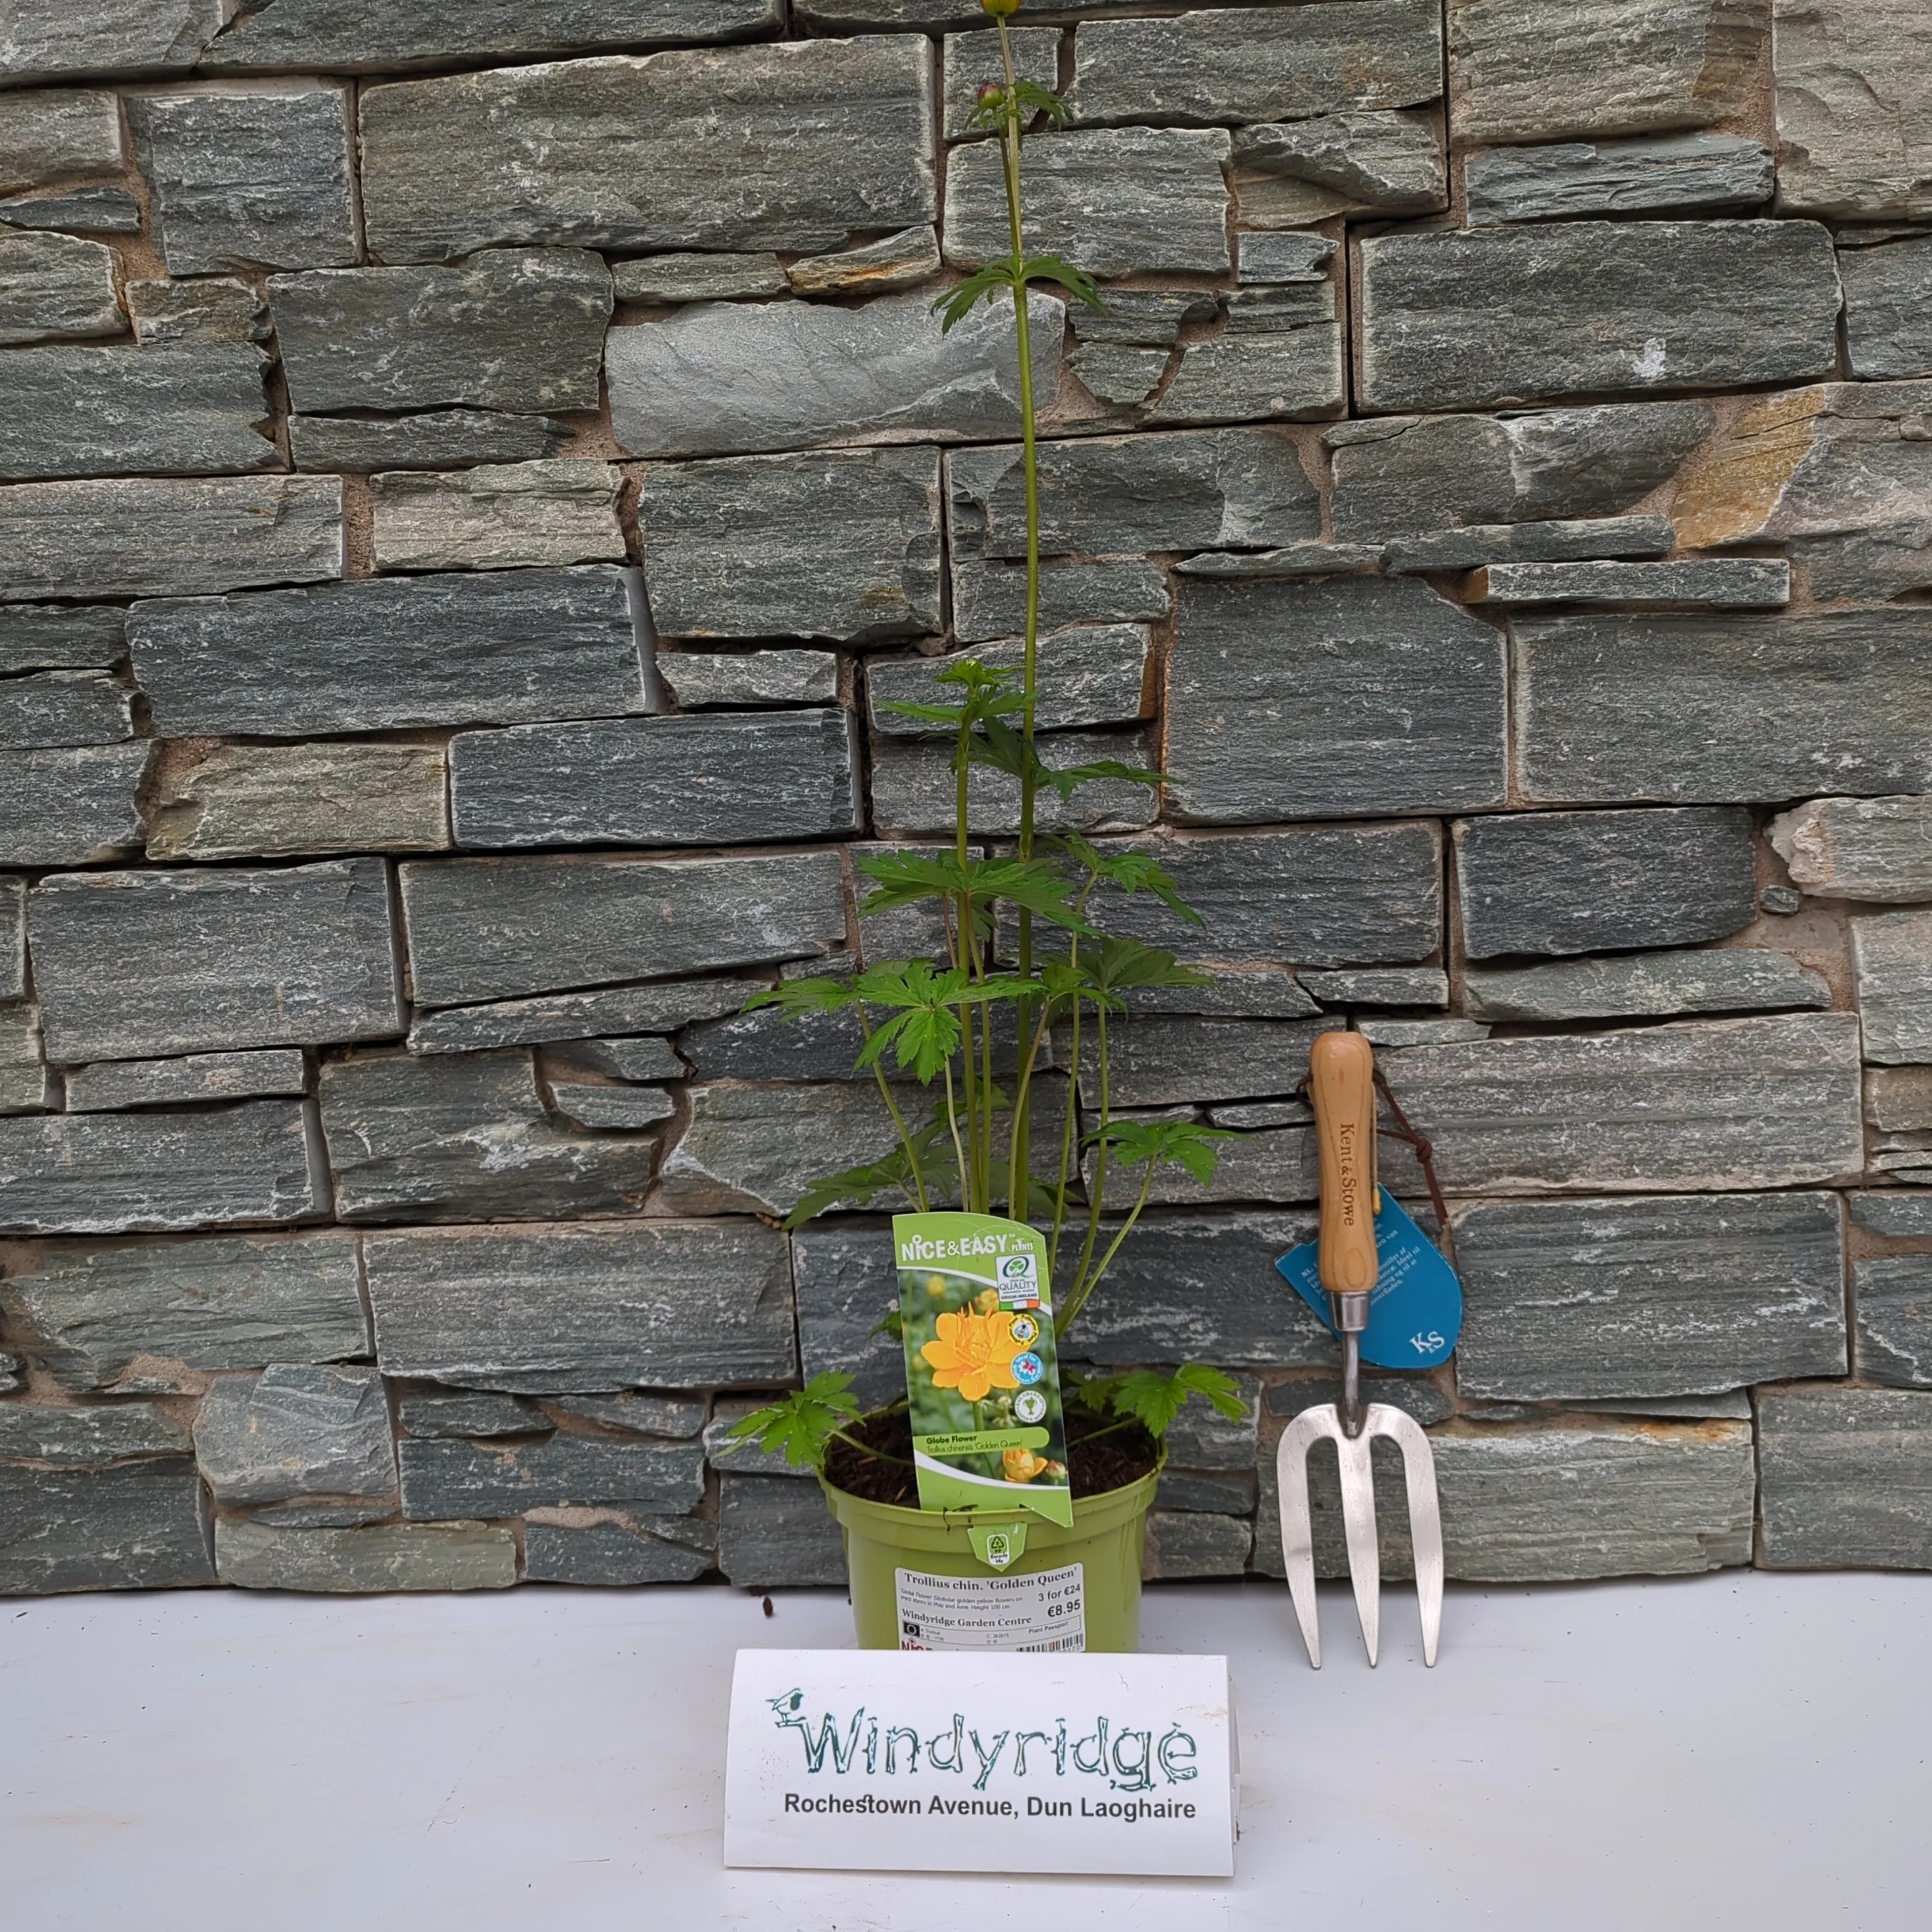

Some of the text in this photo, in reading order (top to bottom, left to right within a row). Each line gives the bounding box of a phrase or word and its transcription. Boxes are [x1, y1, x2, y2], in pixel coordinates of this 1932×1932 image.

[999, 1281, 1036, 1291] QUALITY
[952, 1435, 977, 1443] Flower
[904, 1566, 1077, 1591] Trollius chin. 'Golden Queen'
[1038, 1583, 1080, 1602] 3 for €24
[902, 1608, 1032, 1628] Windyridge Garden Centre
[1048, 1599, 1080, 1618] €8.95
[1044, 1621, 1069, 1632] Passport
[775, 1707, 1198, 1791] Windyridge
[786, 1794, 1196, 1823] Rochestown Avenue, Dun Laoghaire
